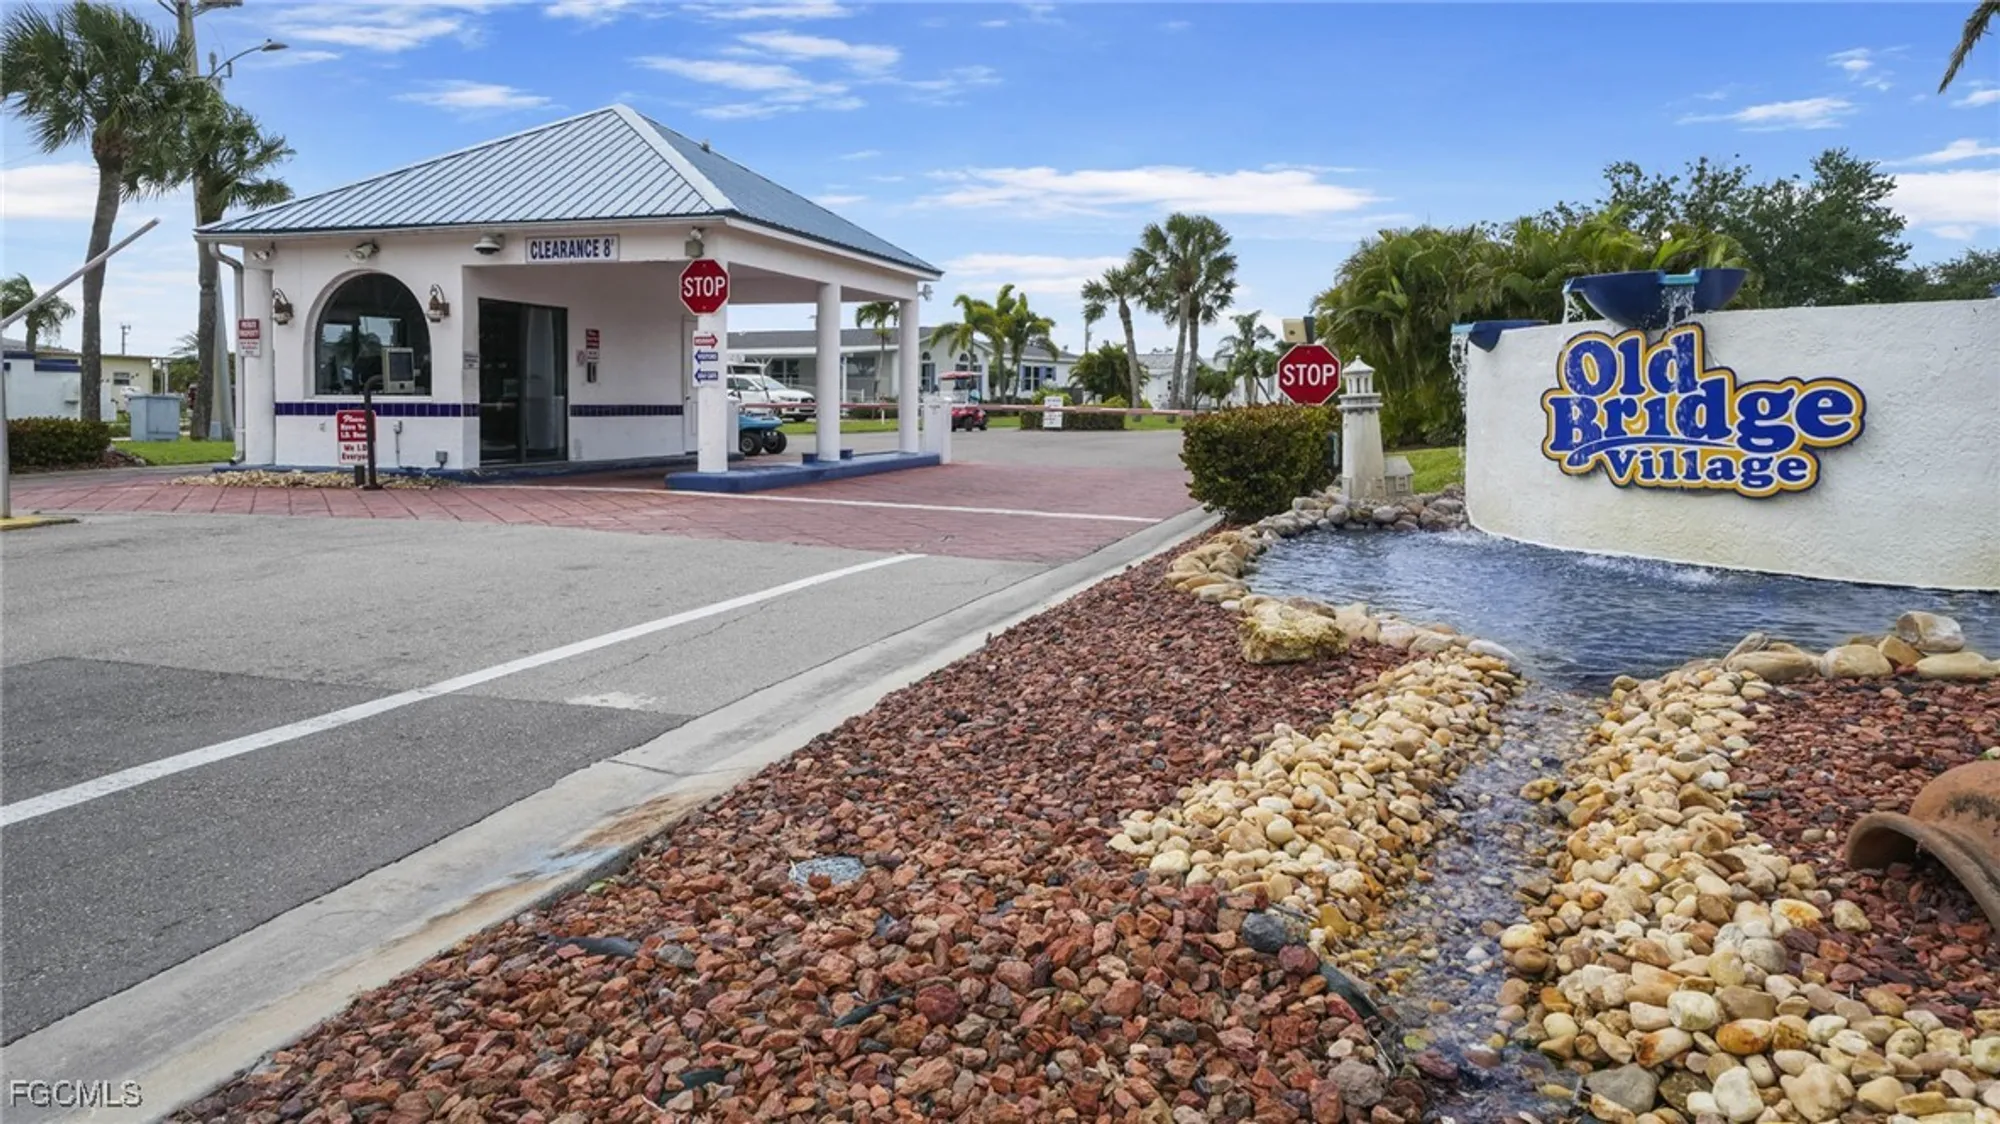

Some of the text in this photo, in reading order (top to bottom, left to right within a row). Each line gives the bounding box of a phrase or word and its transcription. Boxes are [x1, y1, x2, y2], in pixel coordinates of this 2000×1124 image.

[530, 238, 614, 260] CLEARANCE 8'
[683, 276, 726, 297] STOP
[1282, 363, 1336, 386] STOP
[1565, 331, 1700, 397] Old
[1549, 378, 1855, 454] Bridge
[343, 443, 354, 451] We
[1604, 449, 1808, 489] Village
